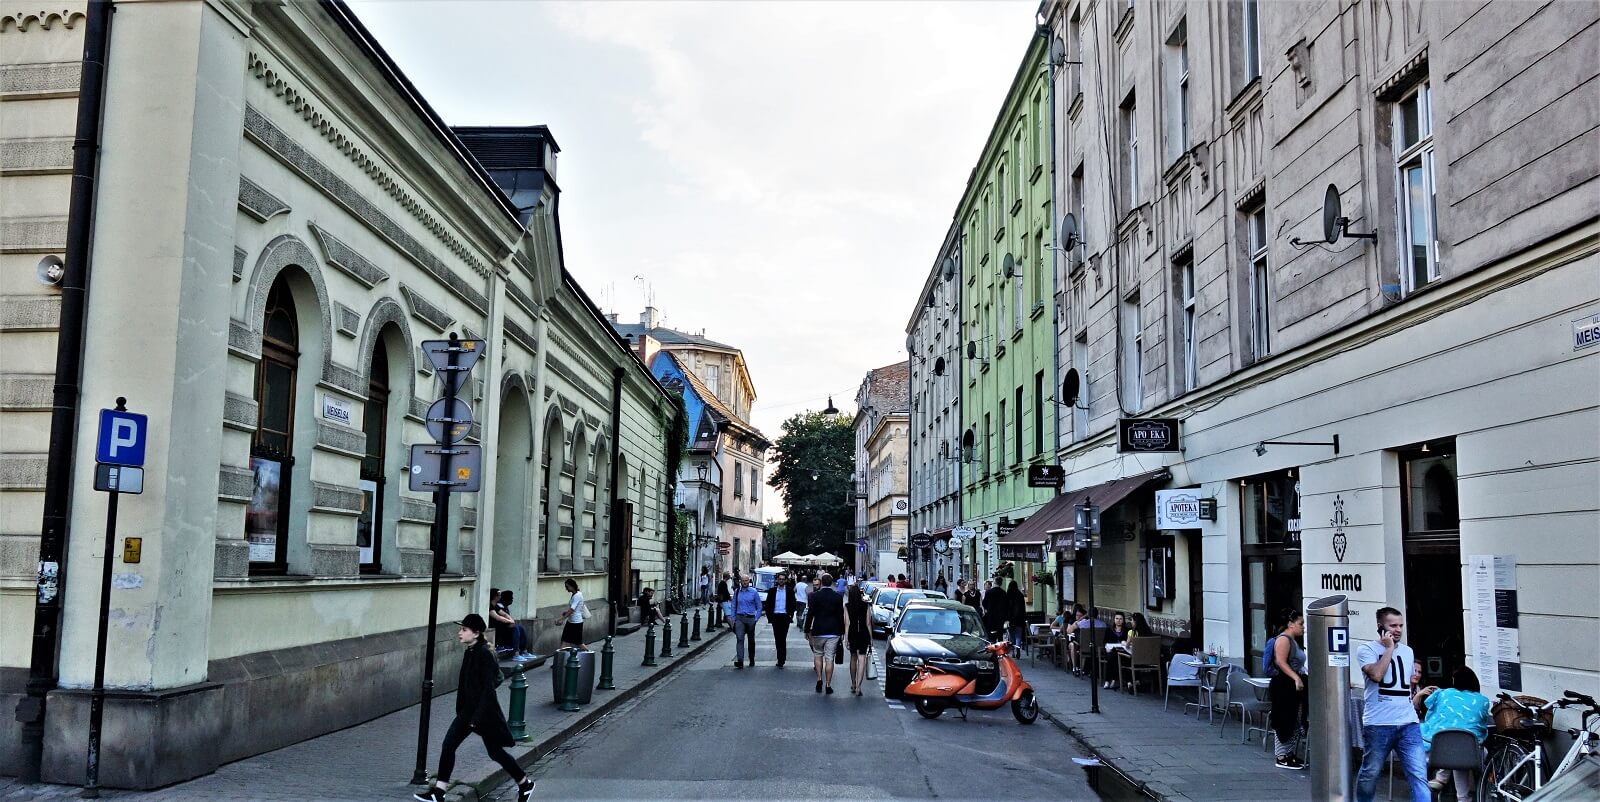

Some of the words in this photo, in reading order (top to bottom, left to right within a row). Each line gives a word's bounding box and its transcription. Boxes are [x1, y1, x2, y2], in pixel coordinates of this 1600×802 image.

[109, 416, 138, 458] P
[1134, 430, 1166, 439] APOEKA
[1170, 503, 1198, 513] APOTEKA
[1321, 573, 1362, 591] mama
[1332, 629, 1347, 651] P
